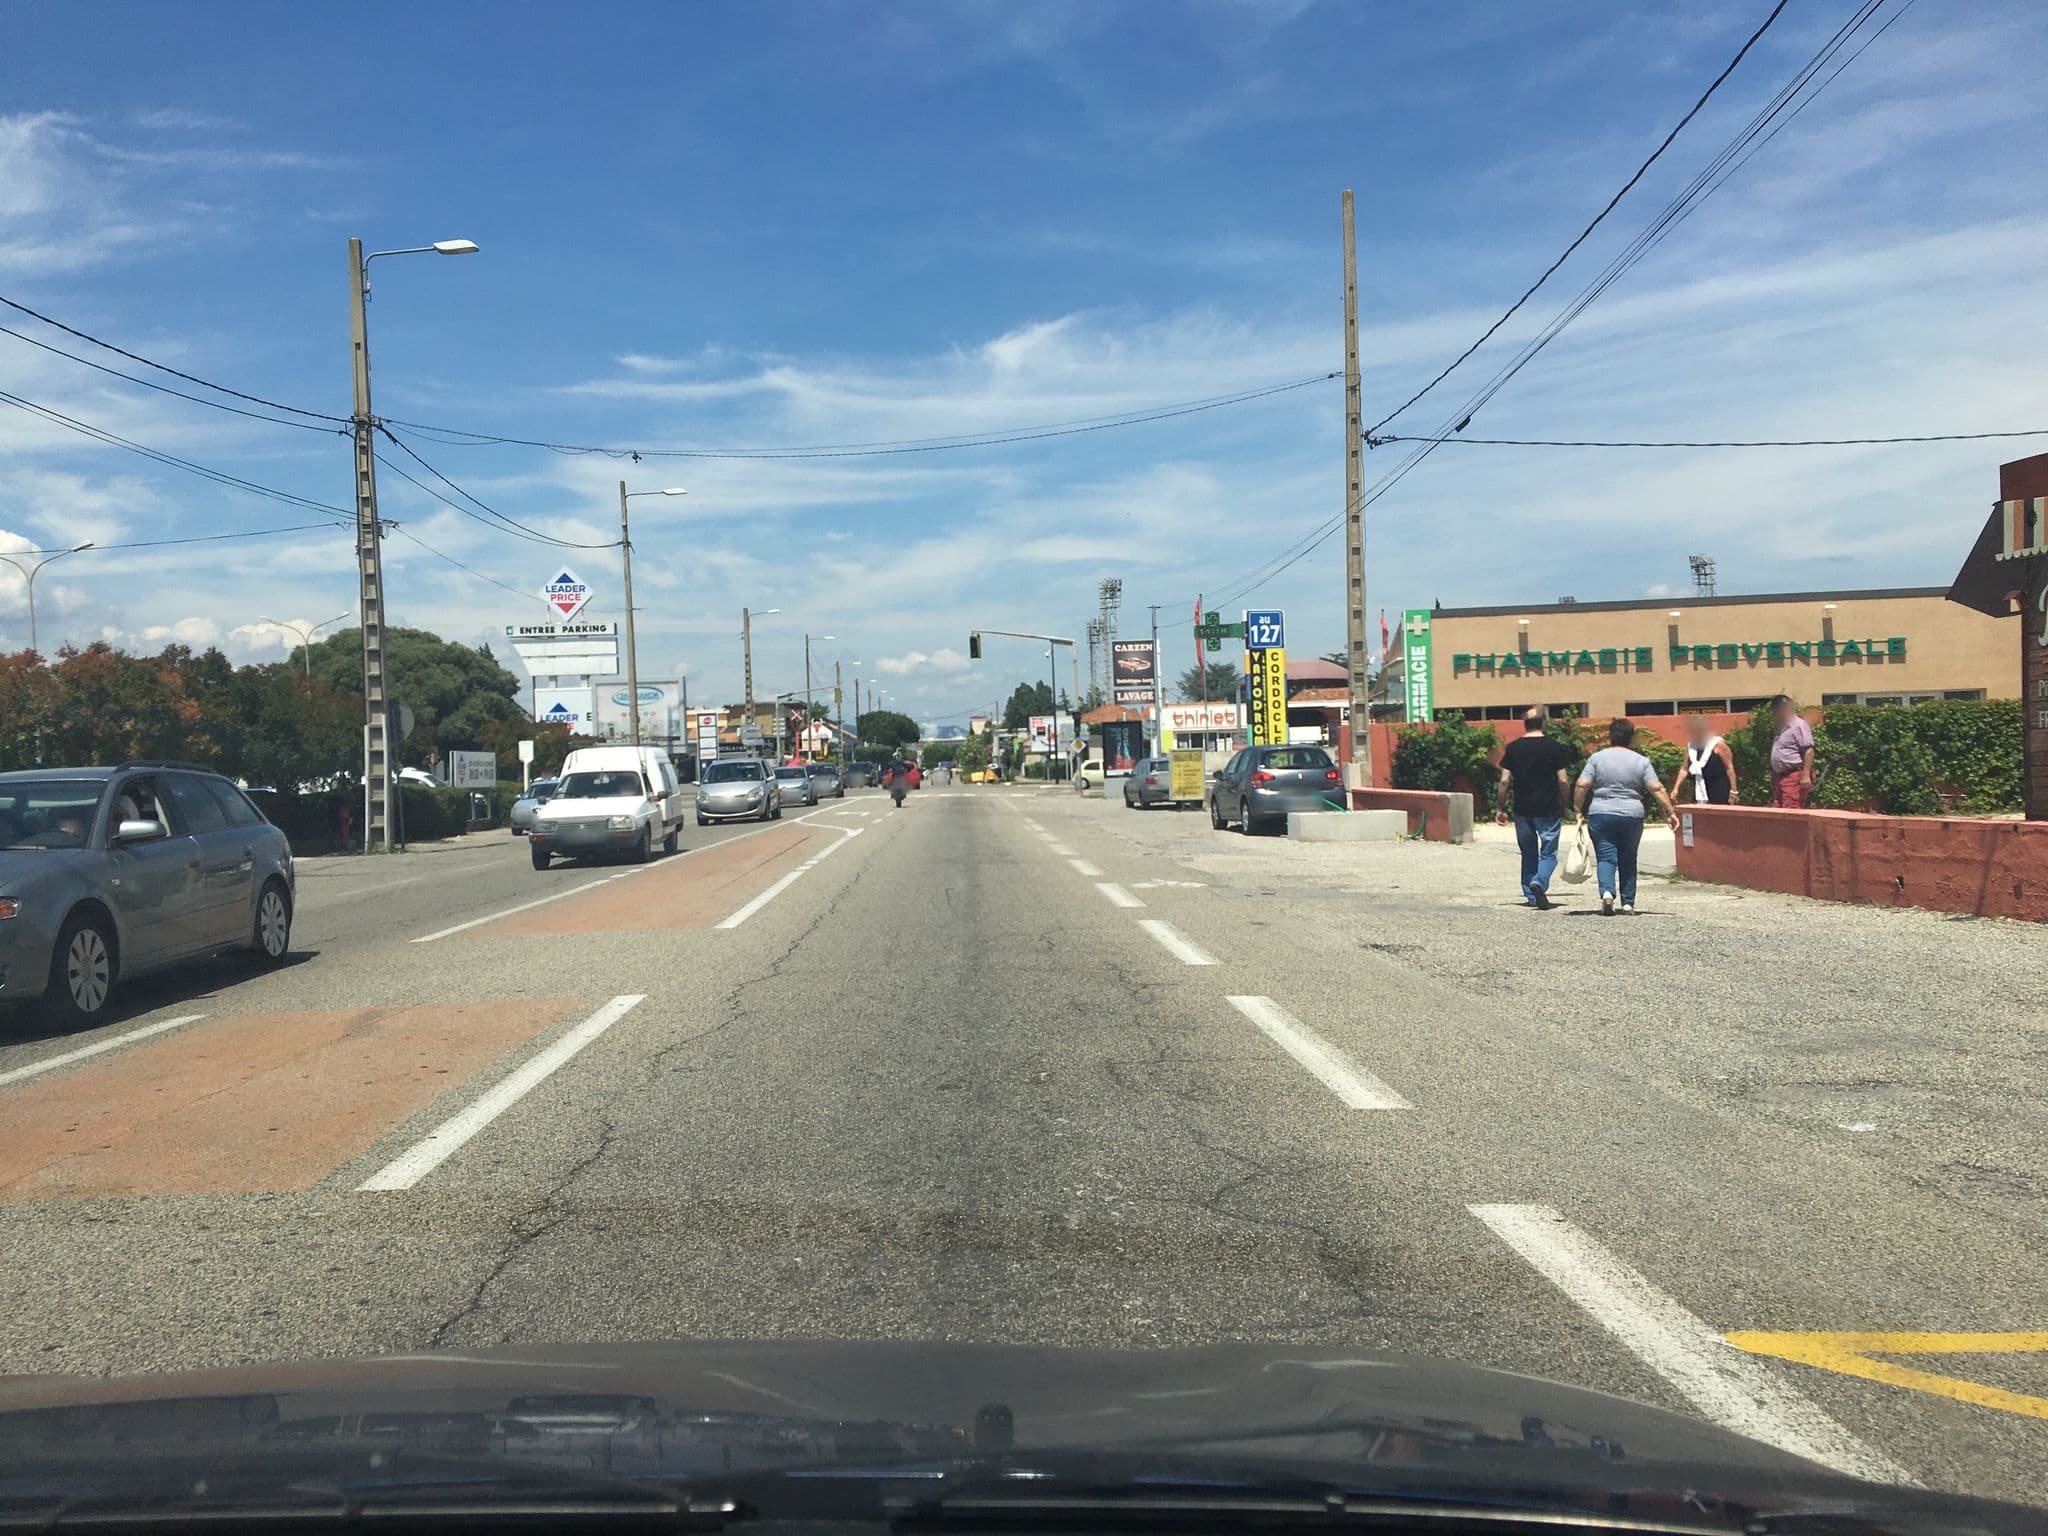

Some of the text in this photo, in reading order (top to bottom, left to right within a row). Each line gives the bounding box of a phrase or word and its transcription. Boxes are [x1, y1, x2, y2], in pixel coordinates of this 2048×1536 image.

[545, 585, 586, 593] LEADER
[550, 593, 582, 601] PRICE
[1258, 615, 1271, 624] au
[519, 624, 608, 635] ENTREE PARKING
[1250, 625, 1281, 643] 127
[1114, 643, 1153, 652] CARZEN
[1452, 646, 1654, 671] PHARMACIE
[1410, 645, 1429, 723] ARMACIE
[1116, 691, 1154, 701] LAVAGE
